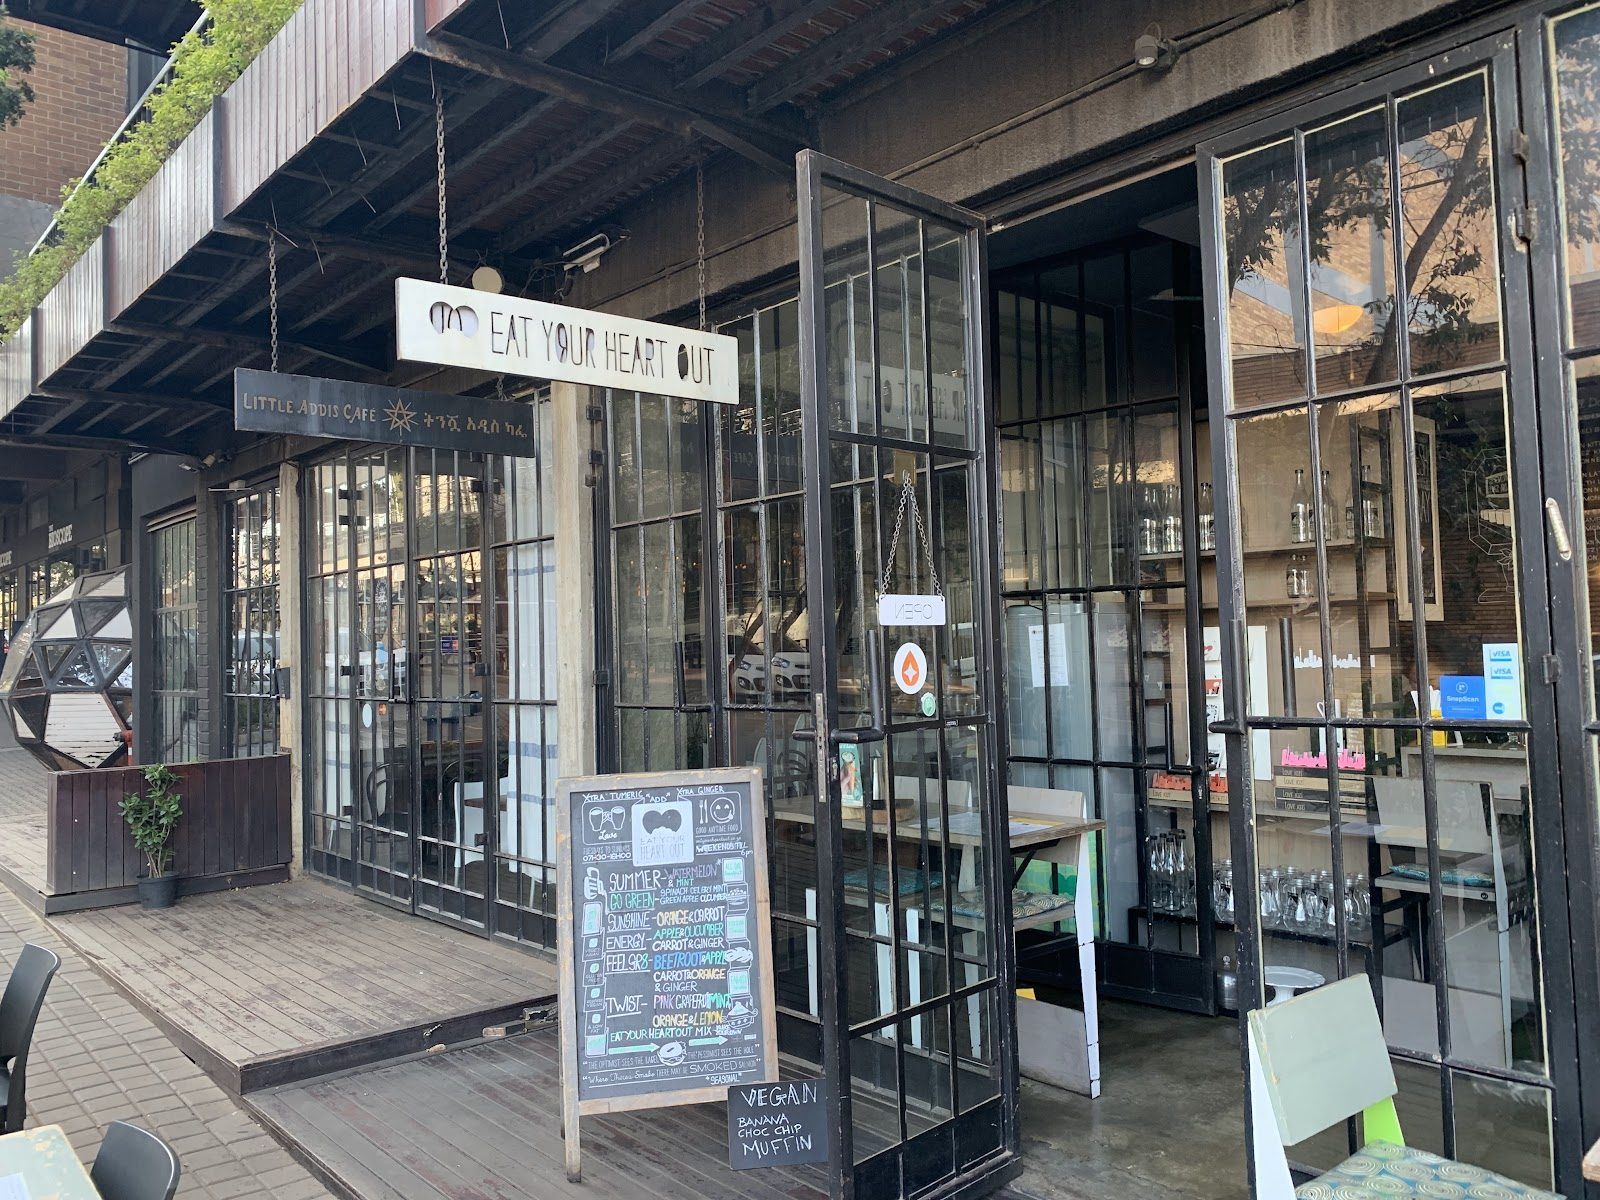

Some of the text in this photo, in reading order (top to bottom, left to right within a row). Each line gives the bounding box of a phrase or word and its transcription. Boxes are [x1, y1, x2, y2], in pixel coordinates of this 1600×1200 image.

[490, 311, 715, 386] EAT YOUR HEART OUT
[243, 392, 294, 414] LITTLE
[297, 401, 339, 418] ADDIS
[1446, 695, 1480, 703] SnapScan
[698, 785, 725, 794] GINGER
[610, 869, 661, 891] SUMMER
[676, 878, 694, 887] MINT
[610, 892, 655, 910] GO GREEN
[608, 912, 650, 928] SUNSHINE
[606, 933, 646, 949] ENERGY
[606, 954, 628, 971] FEEL
[662, 981, 698, 992] GINGER
[606, 995, 643, 1013] TWIST
[654, 994, 675, 1009] PINK
[695, 1026, 712, 1036] MIX
[689, 1060, 737, 1073] SMOKED
[740, 1082, 817, 1107] VEGAN
[737, 1113, 789, 1127] BANANA
[738, 1123, 802, 1138] CHOC CHIP
[742, 1134, 812, 1159] MUFFIN
